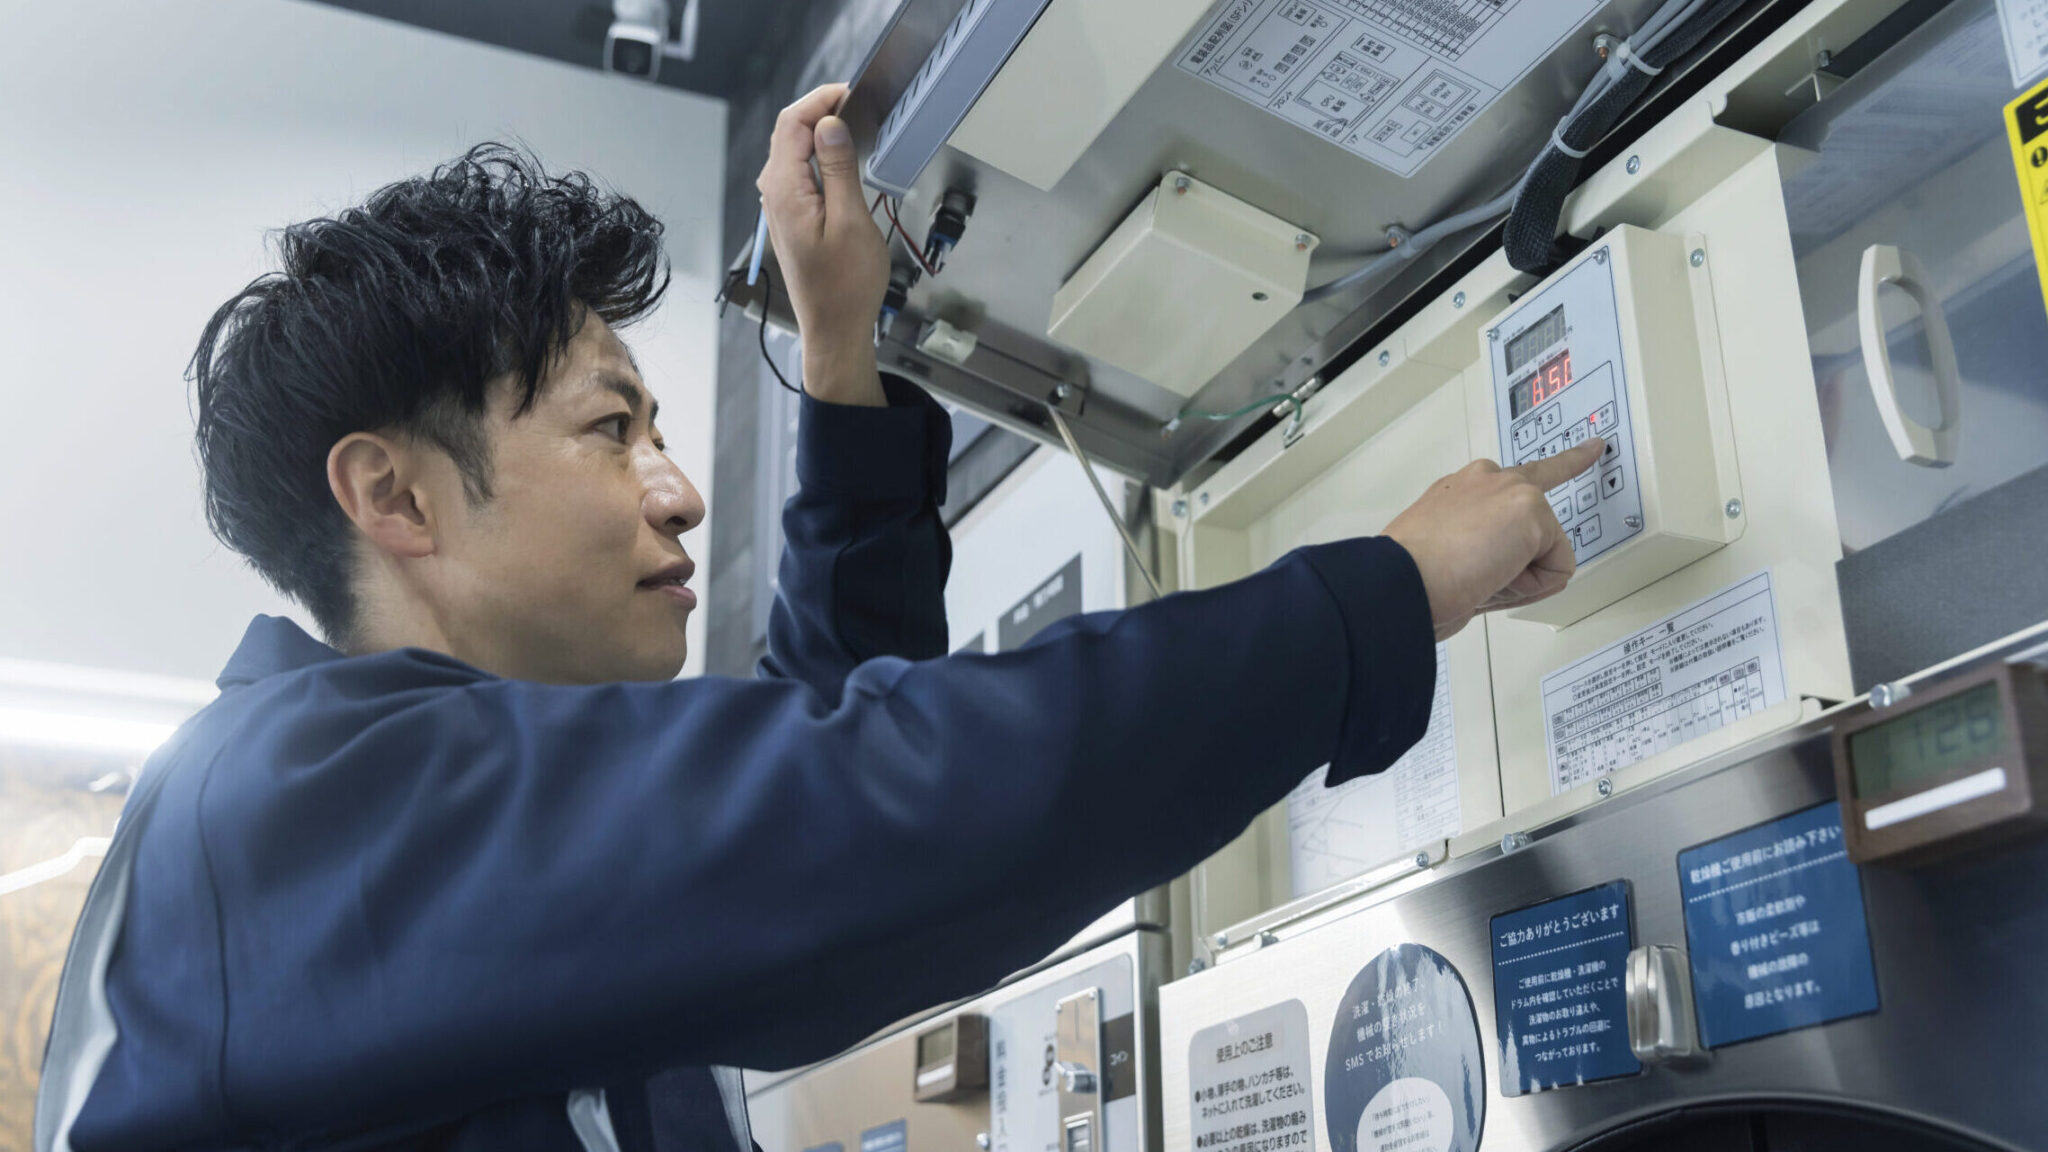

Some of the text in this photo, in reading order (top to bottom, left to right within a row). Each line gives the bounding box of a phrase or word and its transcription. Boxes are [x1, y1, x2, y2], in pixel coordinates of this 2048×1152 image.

[1547, 413, 1554, 425] 3
[1623, 620, 1675, 655] 操作キー 一覧
[1498, 901, 1620, 949] ご協力ありがとうございます
[1517, 958, 1607, 991] ご使用前に乾燥機・洗濯機の
[1510, 975, 1619, 1011] ドラム内を確認していただくことで
[1743, 976, 1822, 1011] 原因となります。
[1527, 999, 1601, 1026] 洗濯物のお取り違えや、
[1215, 1031, 1273, 1063] 使用上のご注意
[1521, 1017, 1612, 1047] 異物によるトラブルの回避に
[1344, 1053, 1365, 1072] SMS
[1534, 1039, 1601, 1064] つながっております。
[1200, 1079, 1305, 1120] ネットに入れて洗濯してください。
